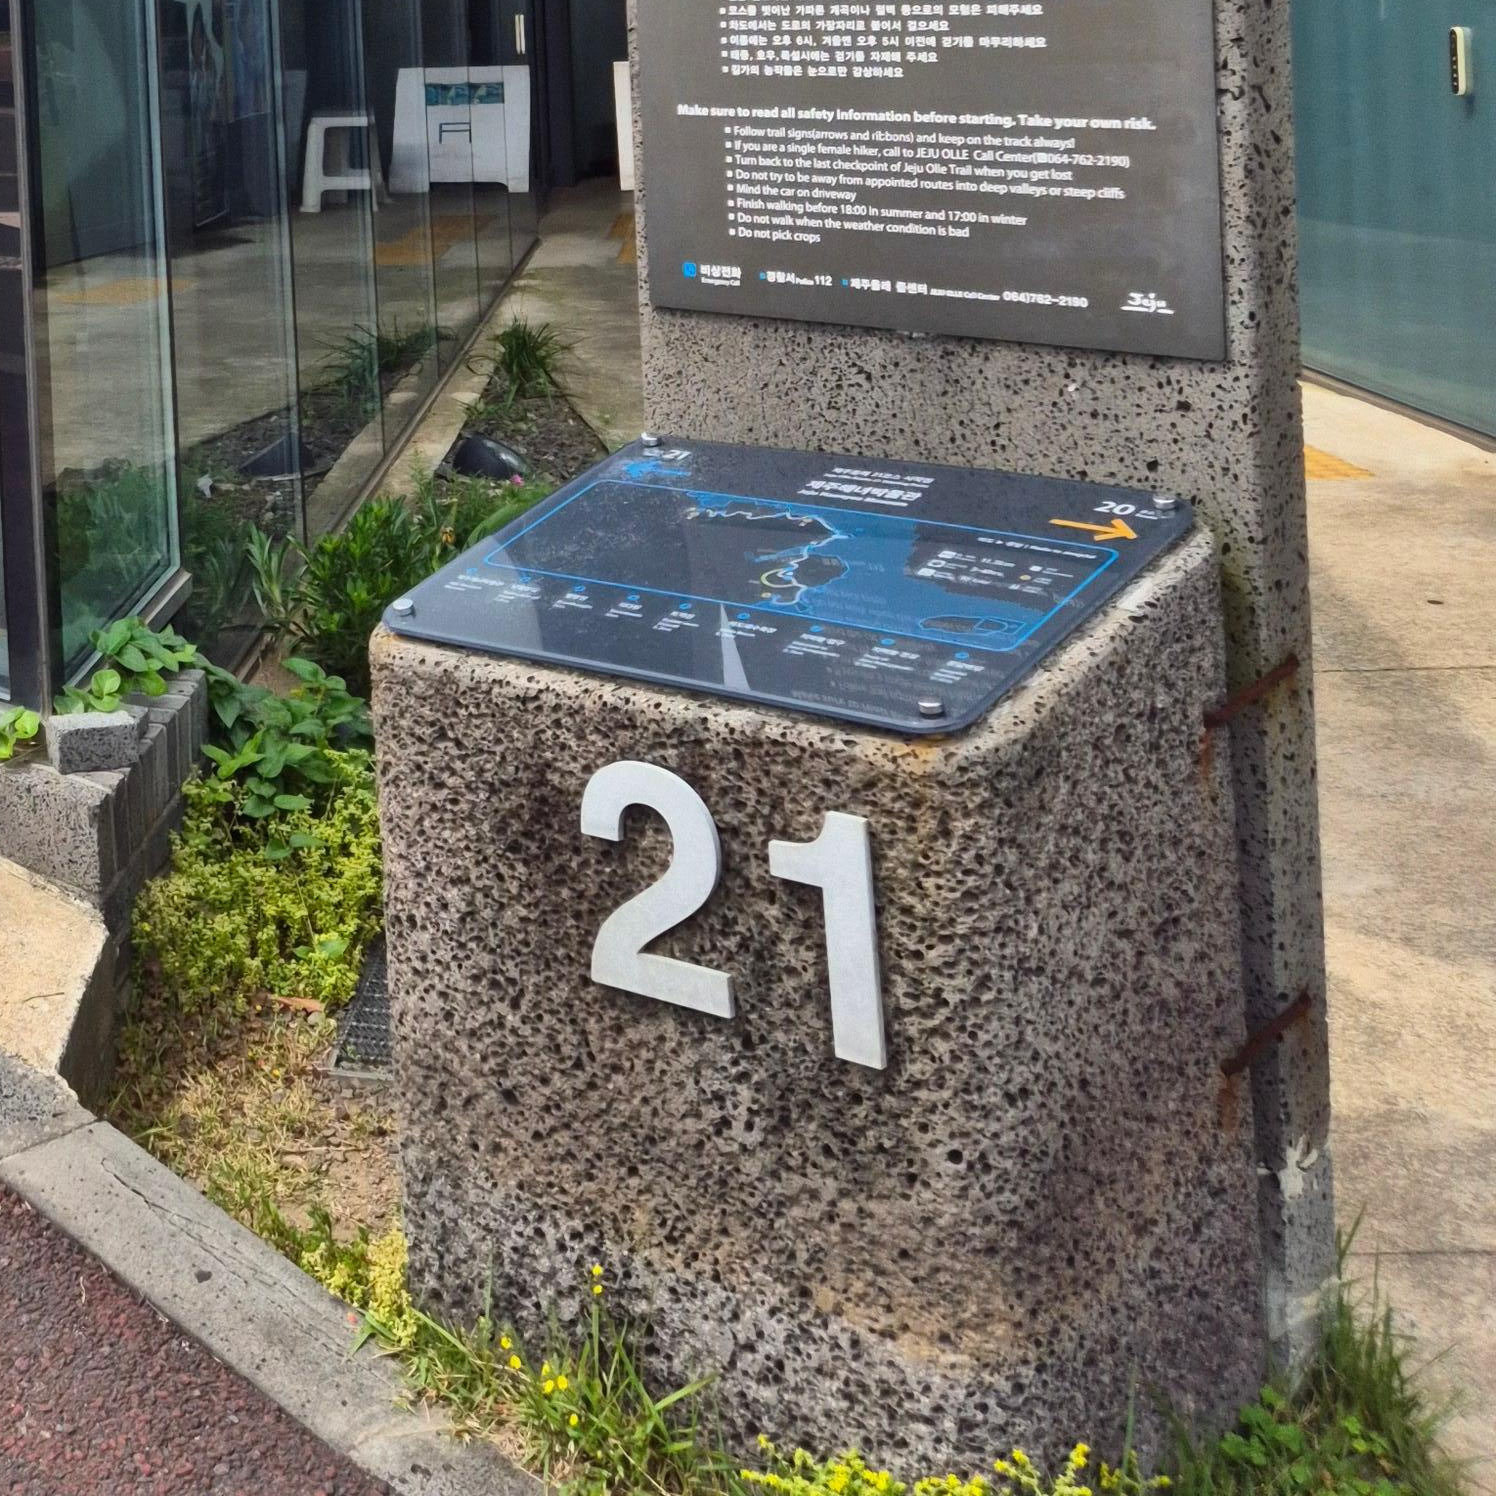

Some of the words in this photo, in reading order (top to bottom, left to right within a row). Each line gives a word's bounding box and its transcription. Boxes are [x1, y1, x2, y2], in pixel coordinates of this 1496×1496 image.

[814, 275, 833, 286] 112
[1094, 501, 1136, 516] 20
[580, 760, 887, 1070] 21
